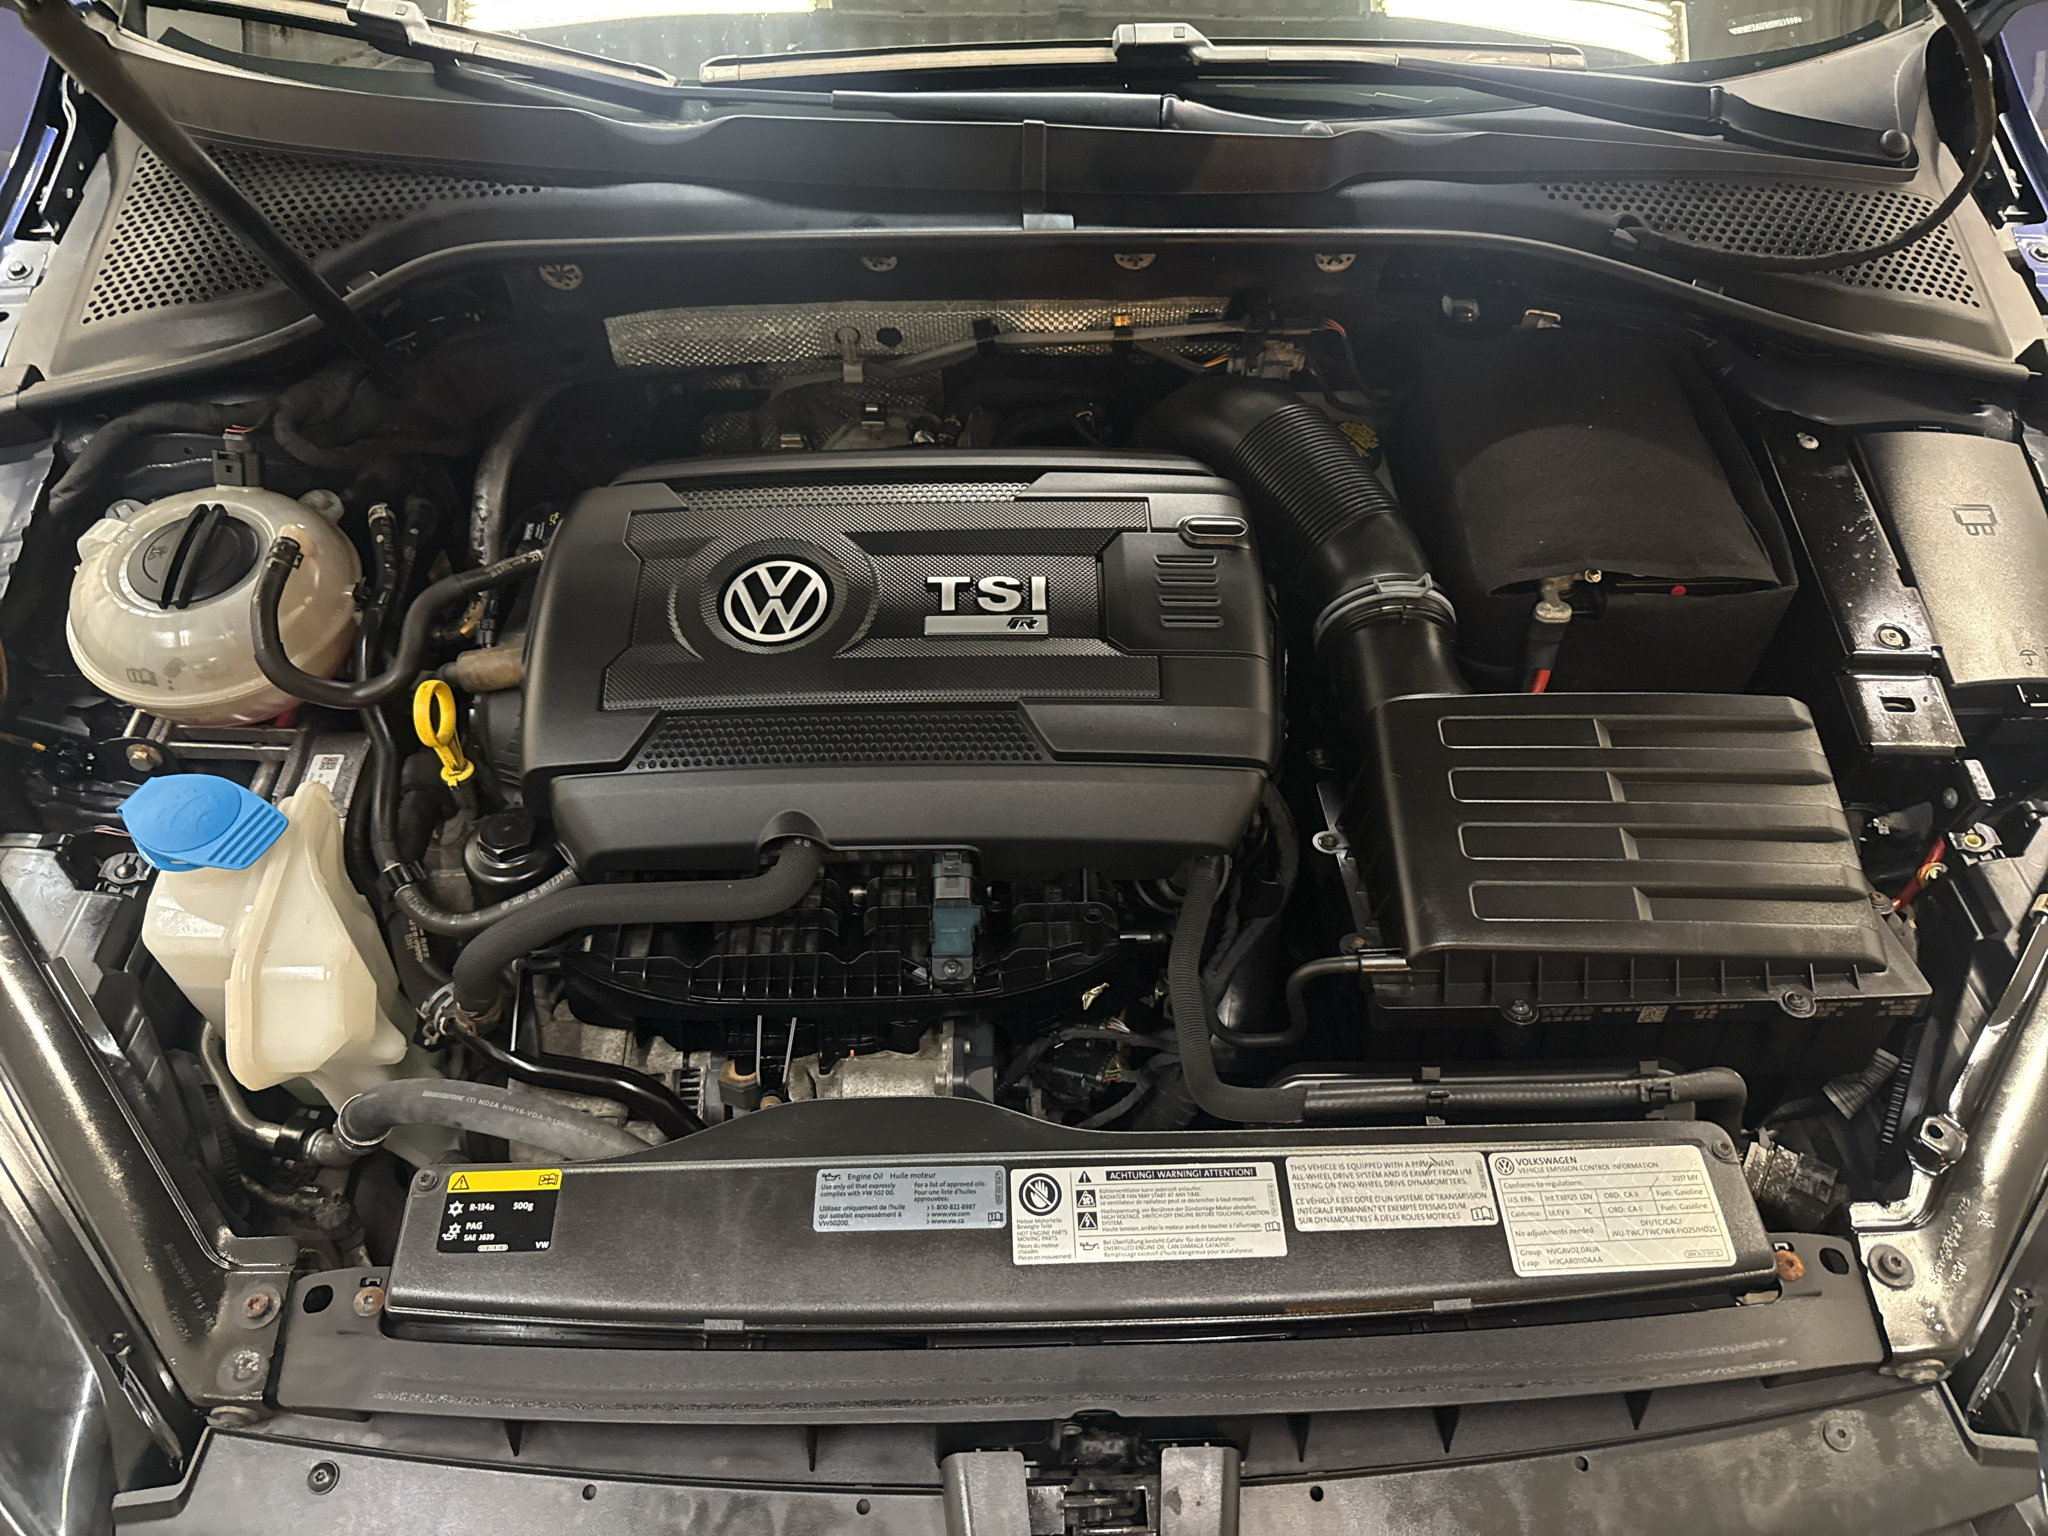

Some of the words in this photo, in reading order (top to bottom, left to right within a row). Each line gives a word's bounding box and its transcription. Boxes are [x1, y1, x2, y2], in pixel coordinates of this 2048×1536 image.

[926, 576, 1047, 612] TSI
[1516, 1156, 1577, 1166] VOLKSWAGEN
[1347, 1162, 1383, 1170] EQUIPPED
[1546, 1165, 1579, 1173] EMISSION
[1612, 1162, 1659, 1170] INFORMATION
[847, 1173, 871, 1182] Engine
[1110, 1171, 1155, 1180] ACHTUNG!
[1157, 1170, 1202, 1178] WARNING!
[1203, 1168, 1254, 1177] ATTENTION!
[1292, 1173, 1332, 1181] ALL-WHEEL
[1356, 1171, 1382, 1179] SYSTEM
[1294, 1182, 1323, 1190] TESTING
[1338, 1180, 1383, 1188] TWO-WHEEL
[1504, 1181, 1535, 1189] Conforms
[1436, 1192, 1487, 1200] TRANSMISSION
[1674, 1188, 1704, 1196] Gasoline
[469, 1203, 495, 1212] R-134a
[513, 1202, 534, 1212] 500g
[1336, 1205, 1377, 1213] PERMANENT
[1679, 1202, 1708, 1210] Gasoline
[1401, 1213, 1425, 1221] ROUES
[465, 1222, 483, 1230] PAG
[478, 1233, 495, 1241] J639
[1526, 1228, 1568, 1238] adjustments
[535, 1241, 549, 1249] VW
